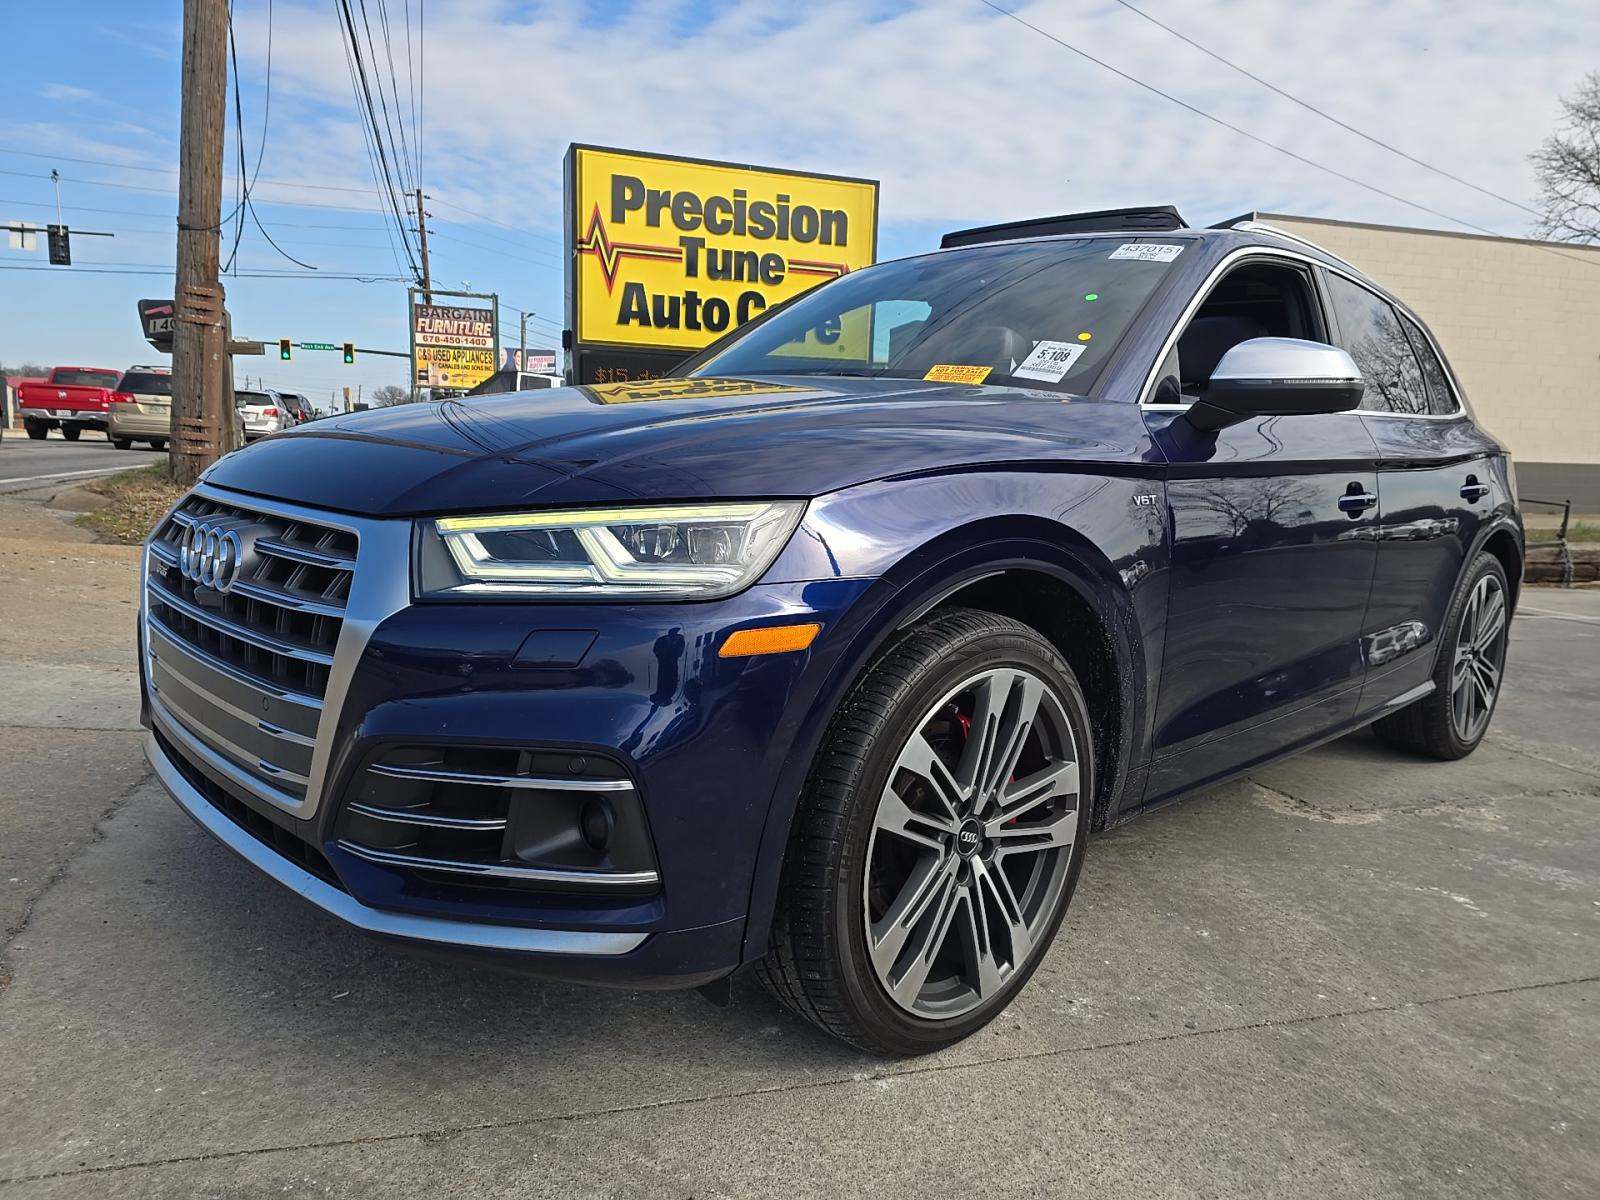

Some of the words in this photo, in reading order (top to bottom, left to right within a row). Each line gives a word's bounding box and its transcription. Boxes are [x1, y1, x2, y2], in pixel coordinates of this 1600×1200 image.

[611, 173, 848, 248] Precision
[679, 235, 786, 286] Tune
[420, 306, 489, 321] BARGAIN
[616, 282, 731, 332] Auto
[417, 318, 492, 336] FURNITURE
[433, 349, 451, 362] USED
[452, 349, 493, 364] APPLIANCES
[1132, 494, 1157, 506] V6T
